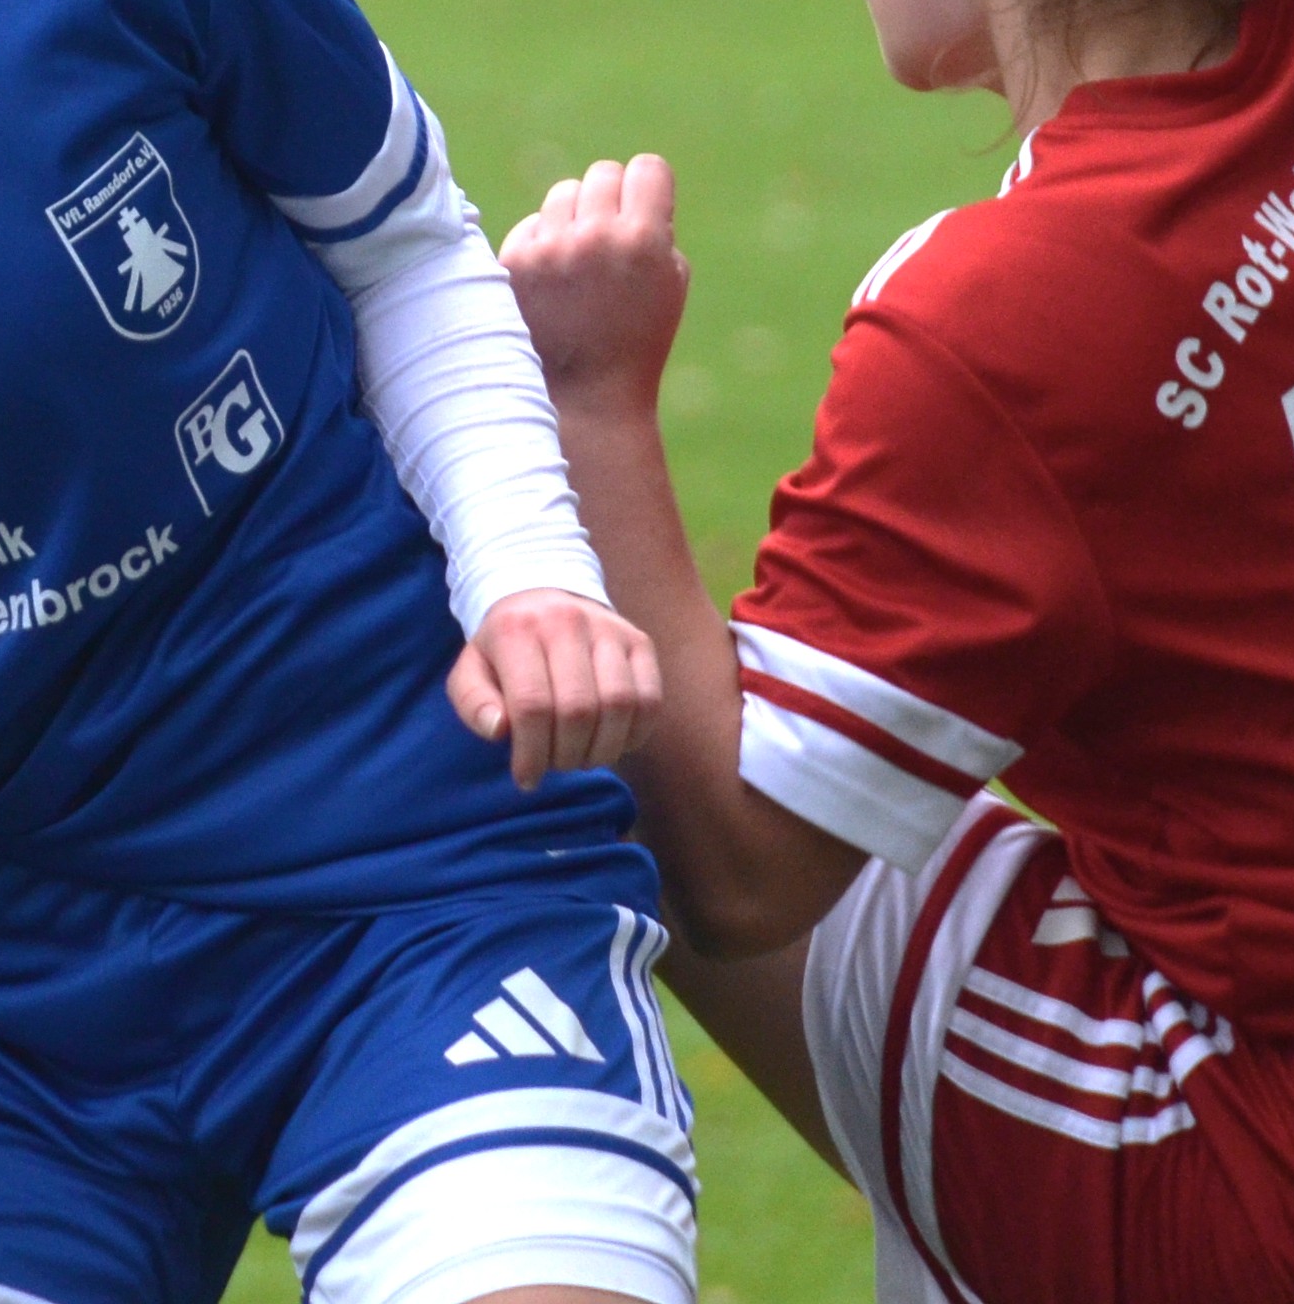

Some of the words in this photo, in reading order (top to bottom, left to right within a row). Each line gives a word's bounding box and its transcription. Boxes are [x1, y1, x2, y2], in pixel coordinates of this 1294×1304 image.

[59, 207, 86, 230] VfL
[83, 159, 137, 215] Ramsdorf
[157, 286, 185, 318] 1936
[1155, 337, 1225, 429] SC
